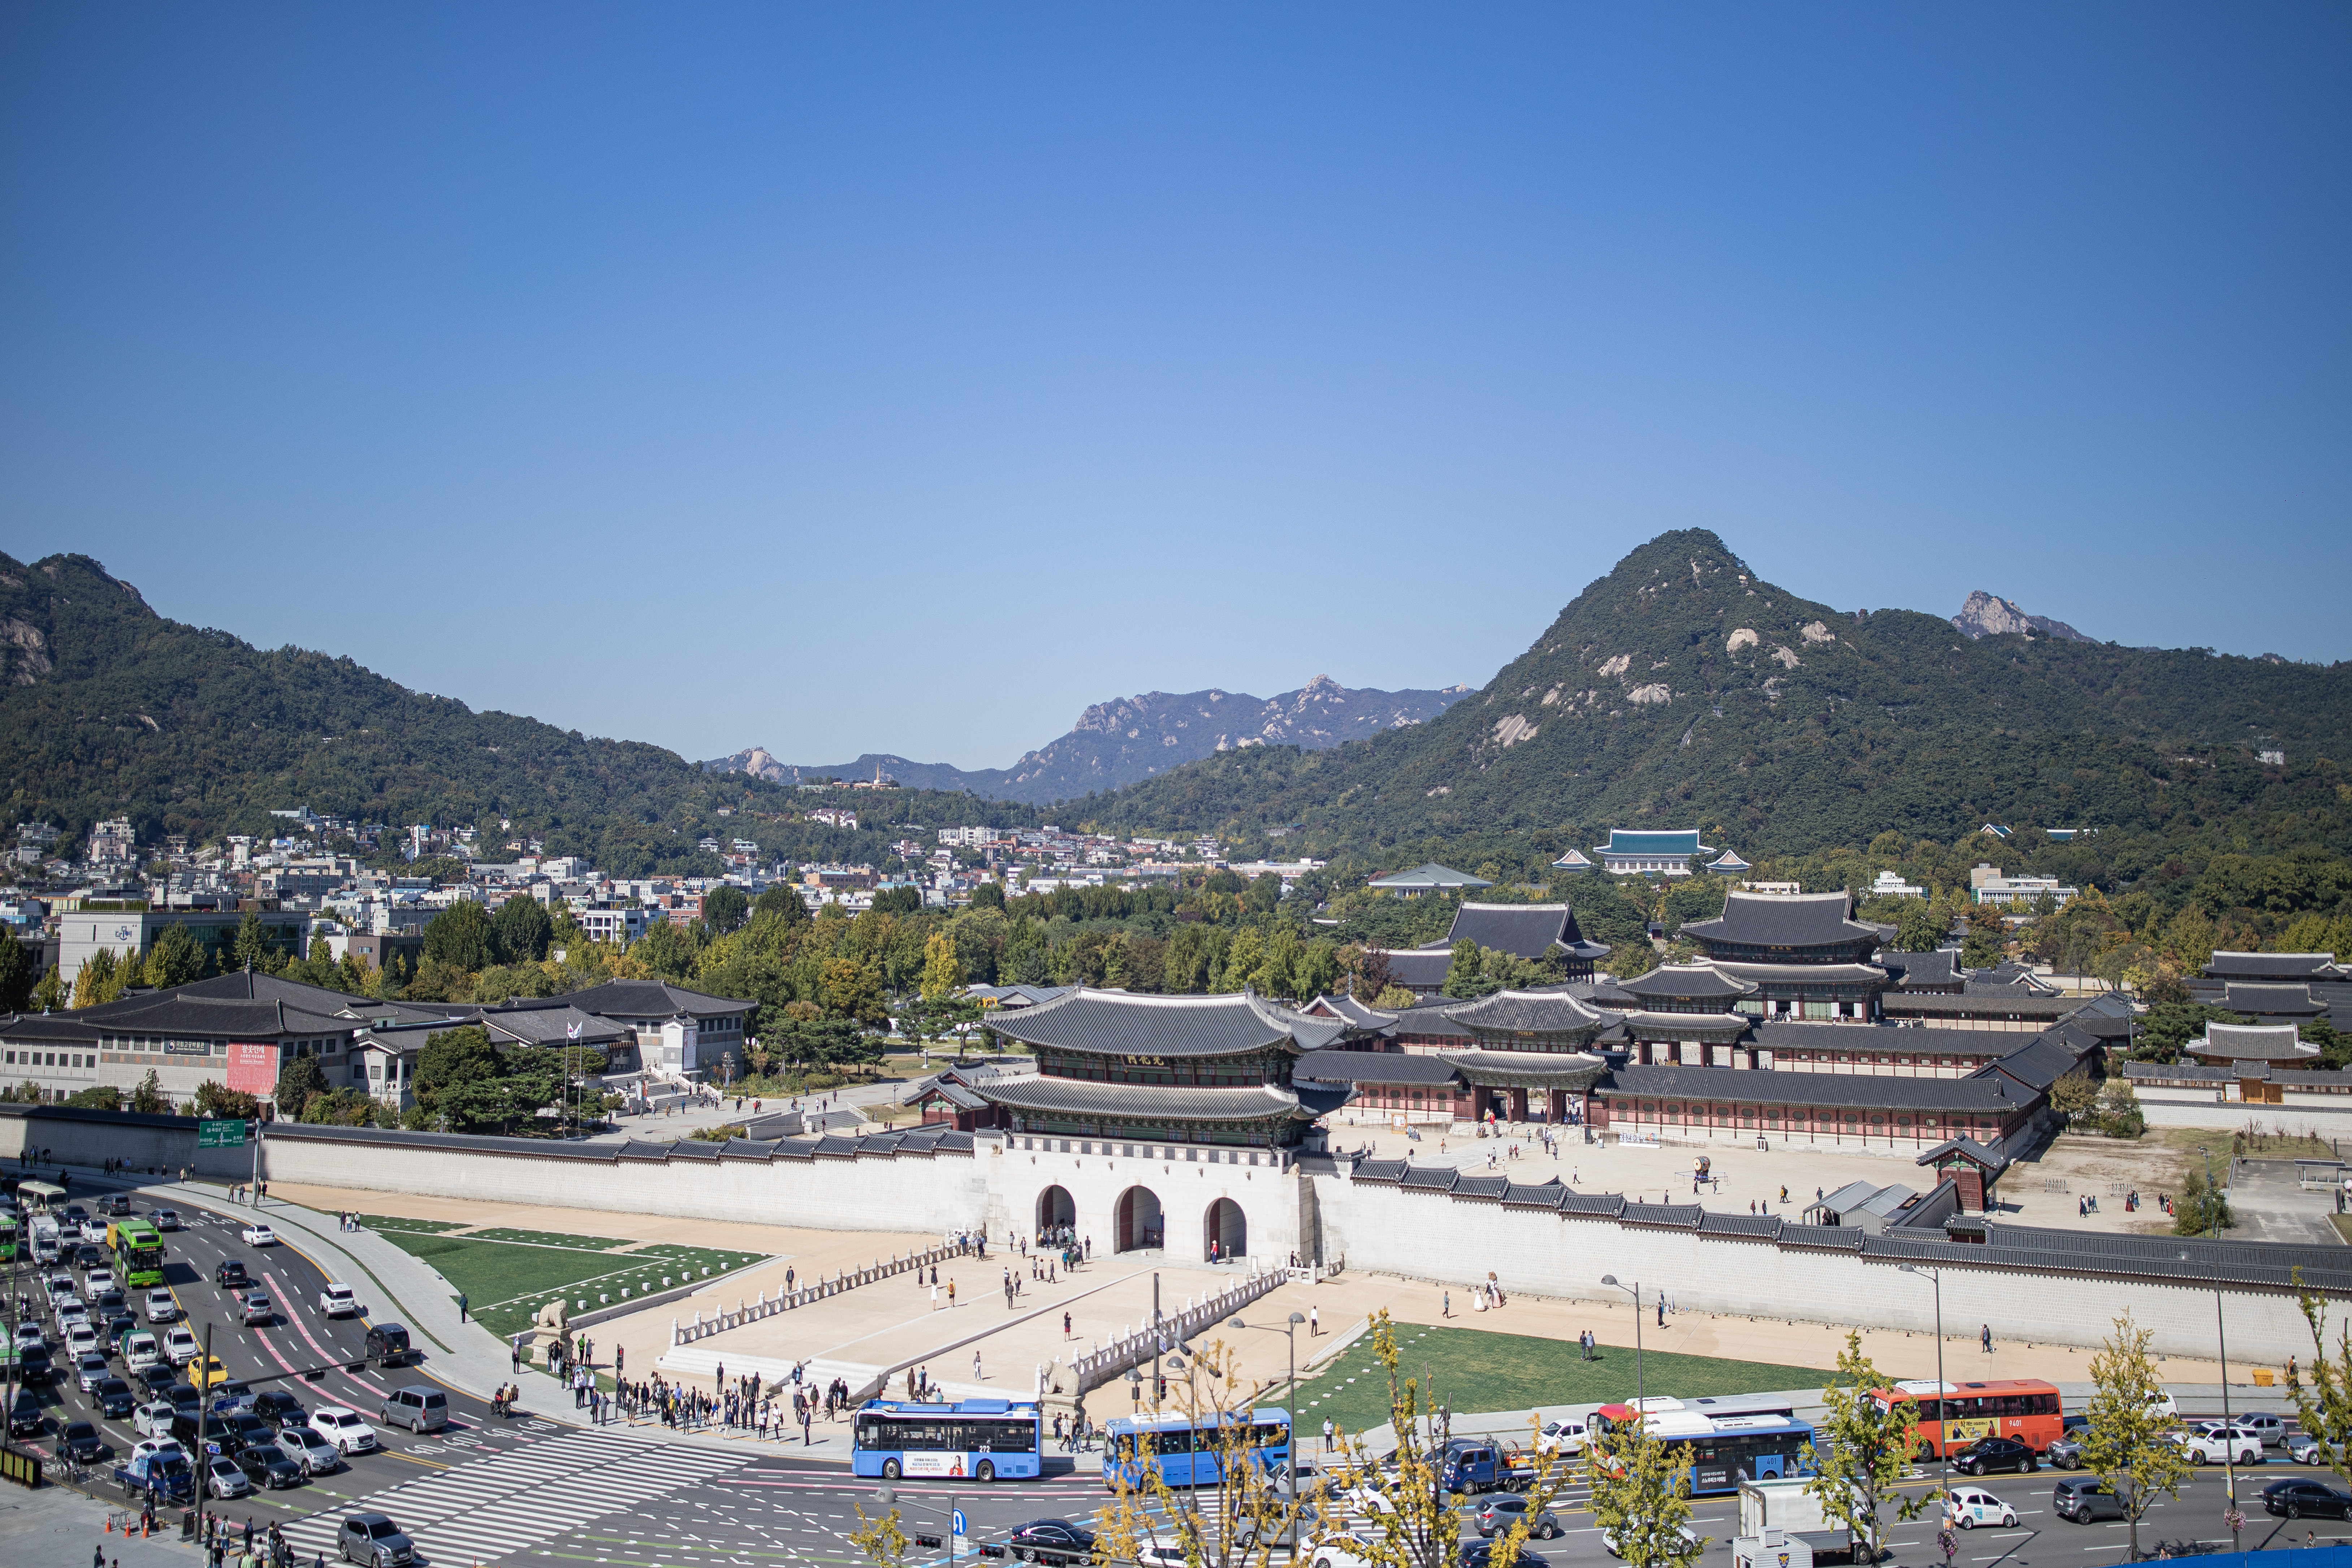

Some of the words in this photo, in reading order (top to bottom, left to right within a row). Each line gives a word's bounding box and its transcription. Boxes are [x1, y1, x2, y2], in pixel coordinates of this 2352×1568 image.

[517, 1420, 558, 1430] 40
[483, 1428, 523, 1438] 40
[442, 1437, 483, 1447] 40
[404, 1444, 446, 1455] 40
